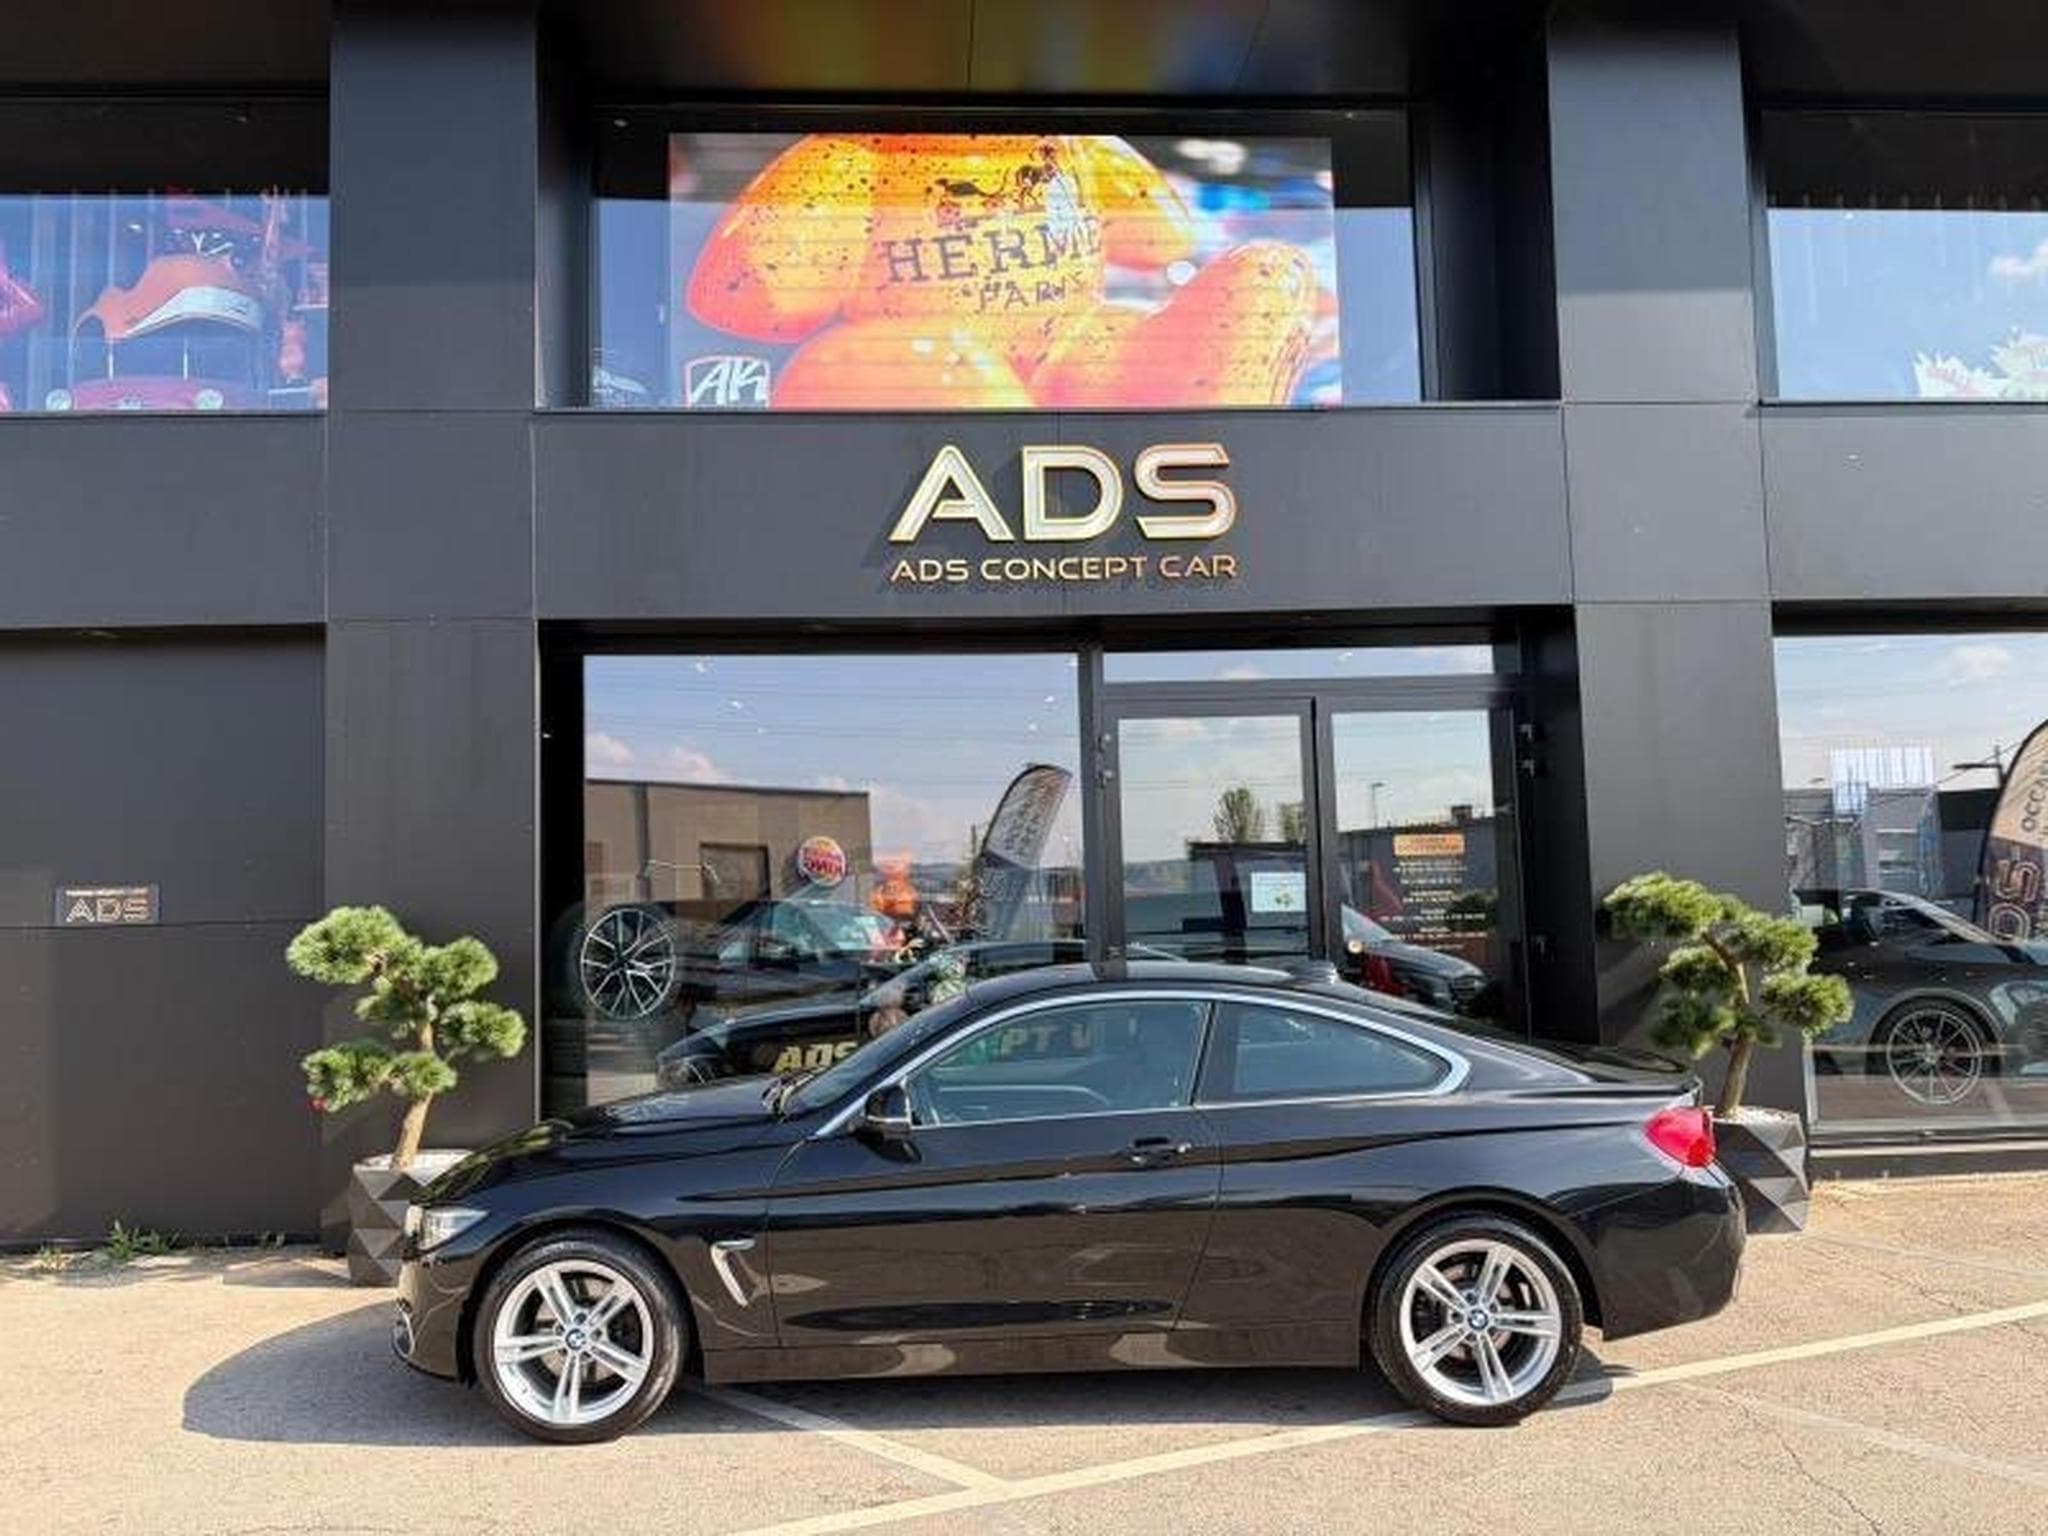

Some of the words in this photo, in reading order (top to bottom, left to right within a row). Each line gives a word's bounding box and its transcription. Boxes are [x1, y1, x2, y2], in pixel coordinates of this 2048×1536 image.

[889, 444, 1237, 541] ADS
[890, 558, 970, 582] ADS
[980, 556, 1148, 581] CONCEPT
[1158, 554, 1237, 579] CAR
[66, 897, 150, 923] ADS
